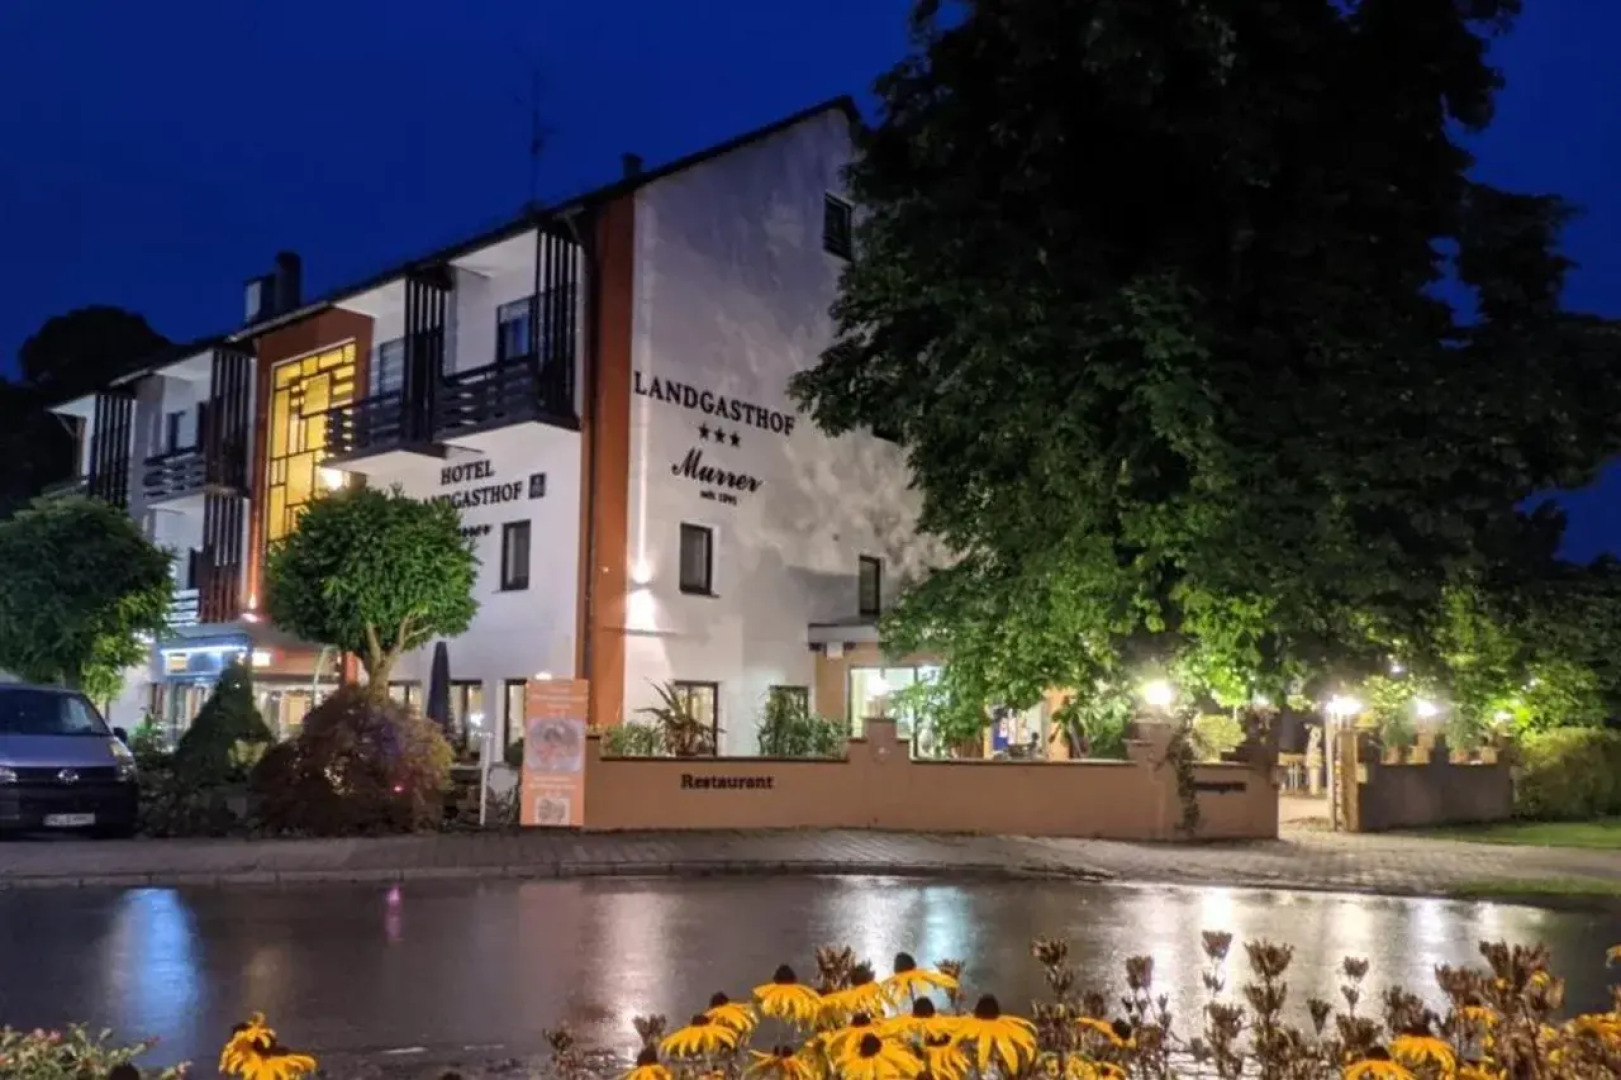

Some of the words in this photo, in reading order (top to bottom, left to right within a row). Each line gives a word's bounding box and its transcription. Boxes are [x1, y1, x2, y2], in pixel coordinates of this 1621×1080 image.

[634, 371, 795, 436] LANDGASTHOF
[440, 459, 496, 486] HOTEL
[671, 448, 763, 492] Murrer
[424, 481, 523, 509] GASTHOF
[680, 773, 775, 790] Restaurant
